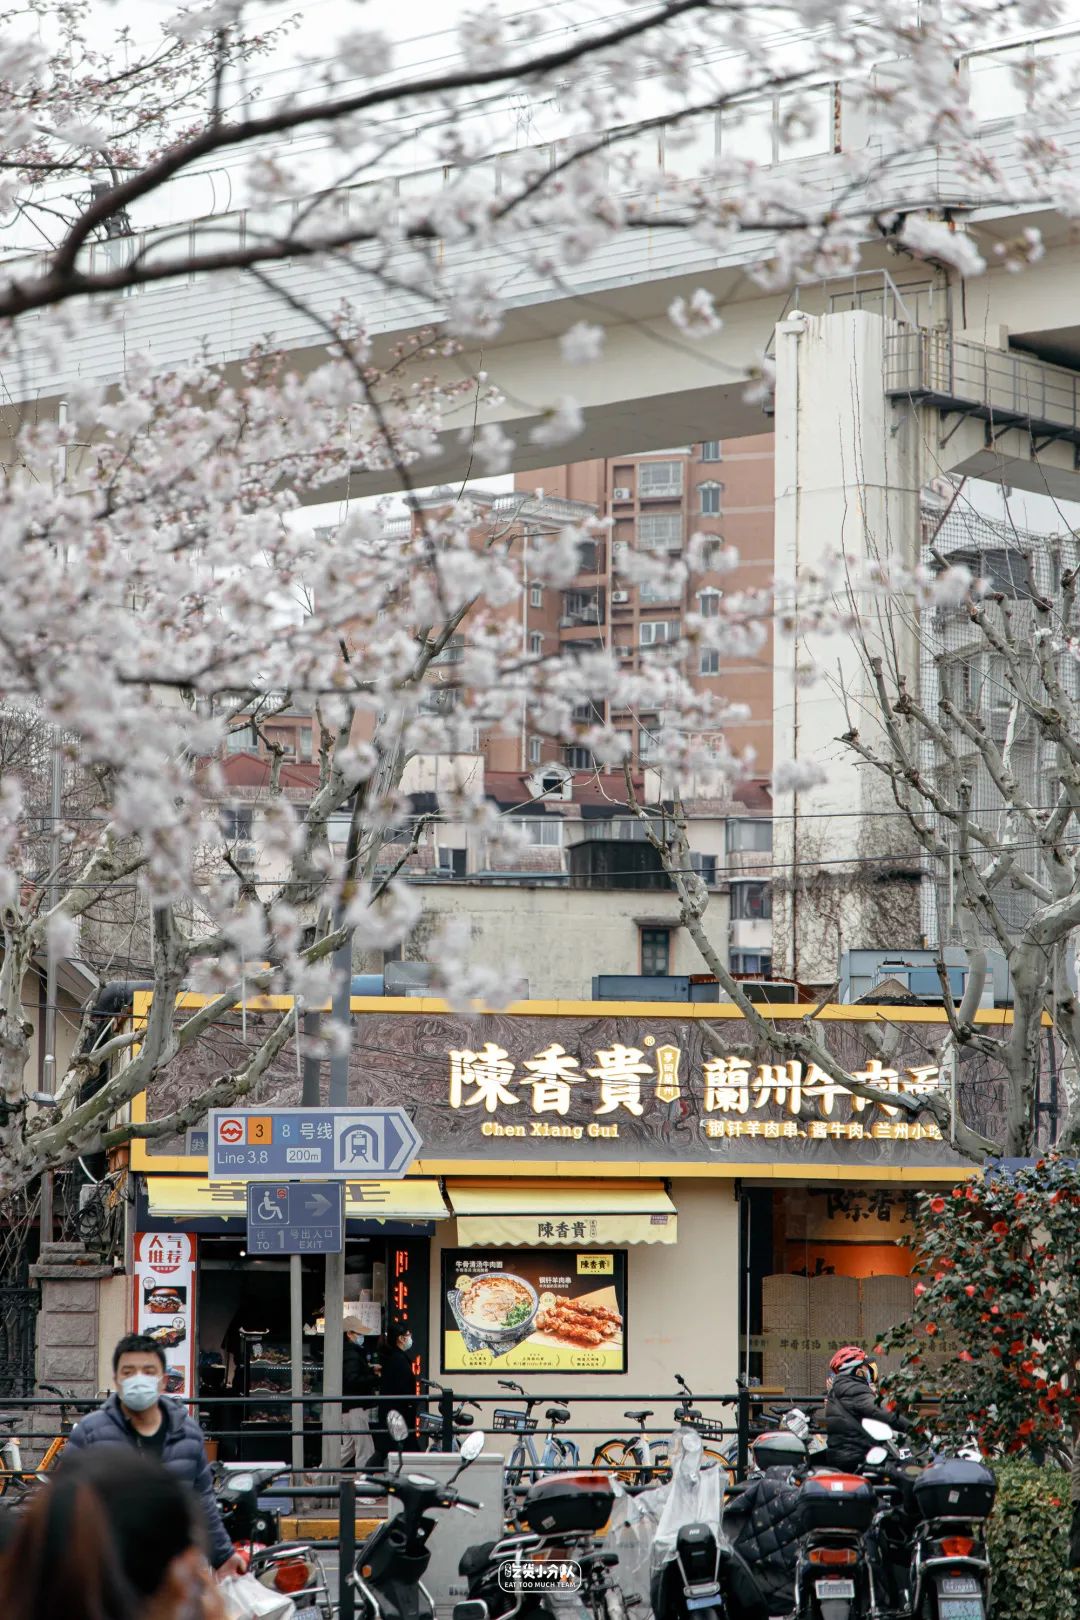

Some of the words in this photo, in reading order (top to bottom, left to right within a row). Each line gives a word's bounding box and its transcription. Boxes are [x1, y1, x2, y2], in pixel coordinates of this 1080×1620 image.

[448, 1042, 653, 1116] 陳香貴
[255, 1124, 264, 1138] 3
[282, 1124, 291, 1138] 8
[299, 1122, 333, 1140] 号线
[481, 1122, 526, 1137] Chen
[530, 1122, 584, 1139] Xiang
[588, 1122, 620, 1138] Gui
[217, 1151, 245, 1164] Line
[247, 1150, 269, 1164] 3.8
[288, 1150, 319, 1161] 200m
[537, 1220, 587, 1239] 陳香貴
[148, 1235, 183, 1249] 人气
[277, 1230, 285, 1249] 1
[299, 1240, 324, 1249] EXIT
[148, 1250, 183, 1263] 推荐
